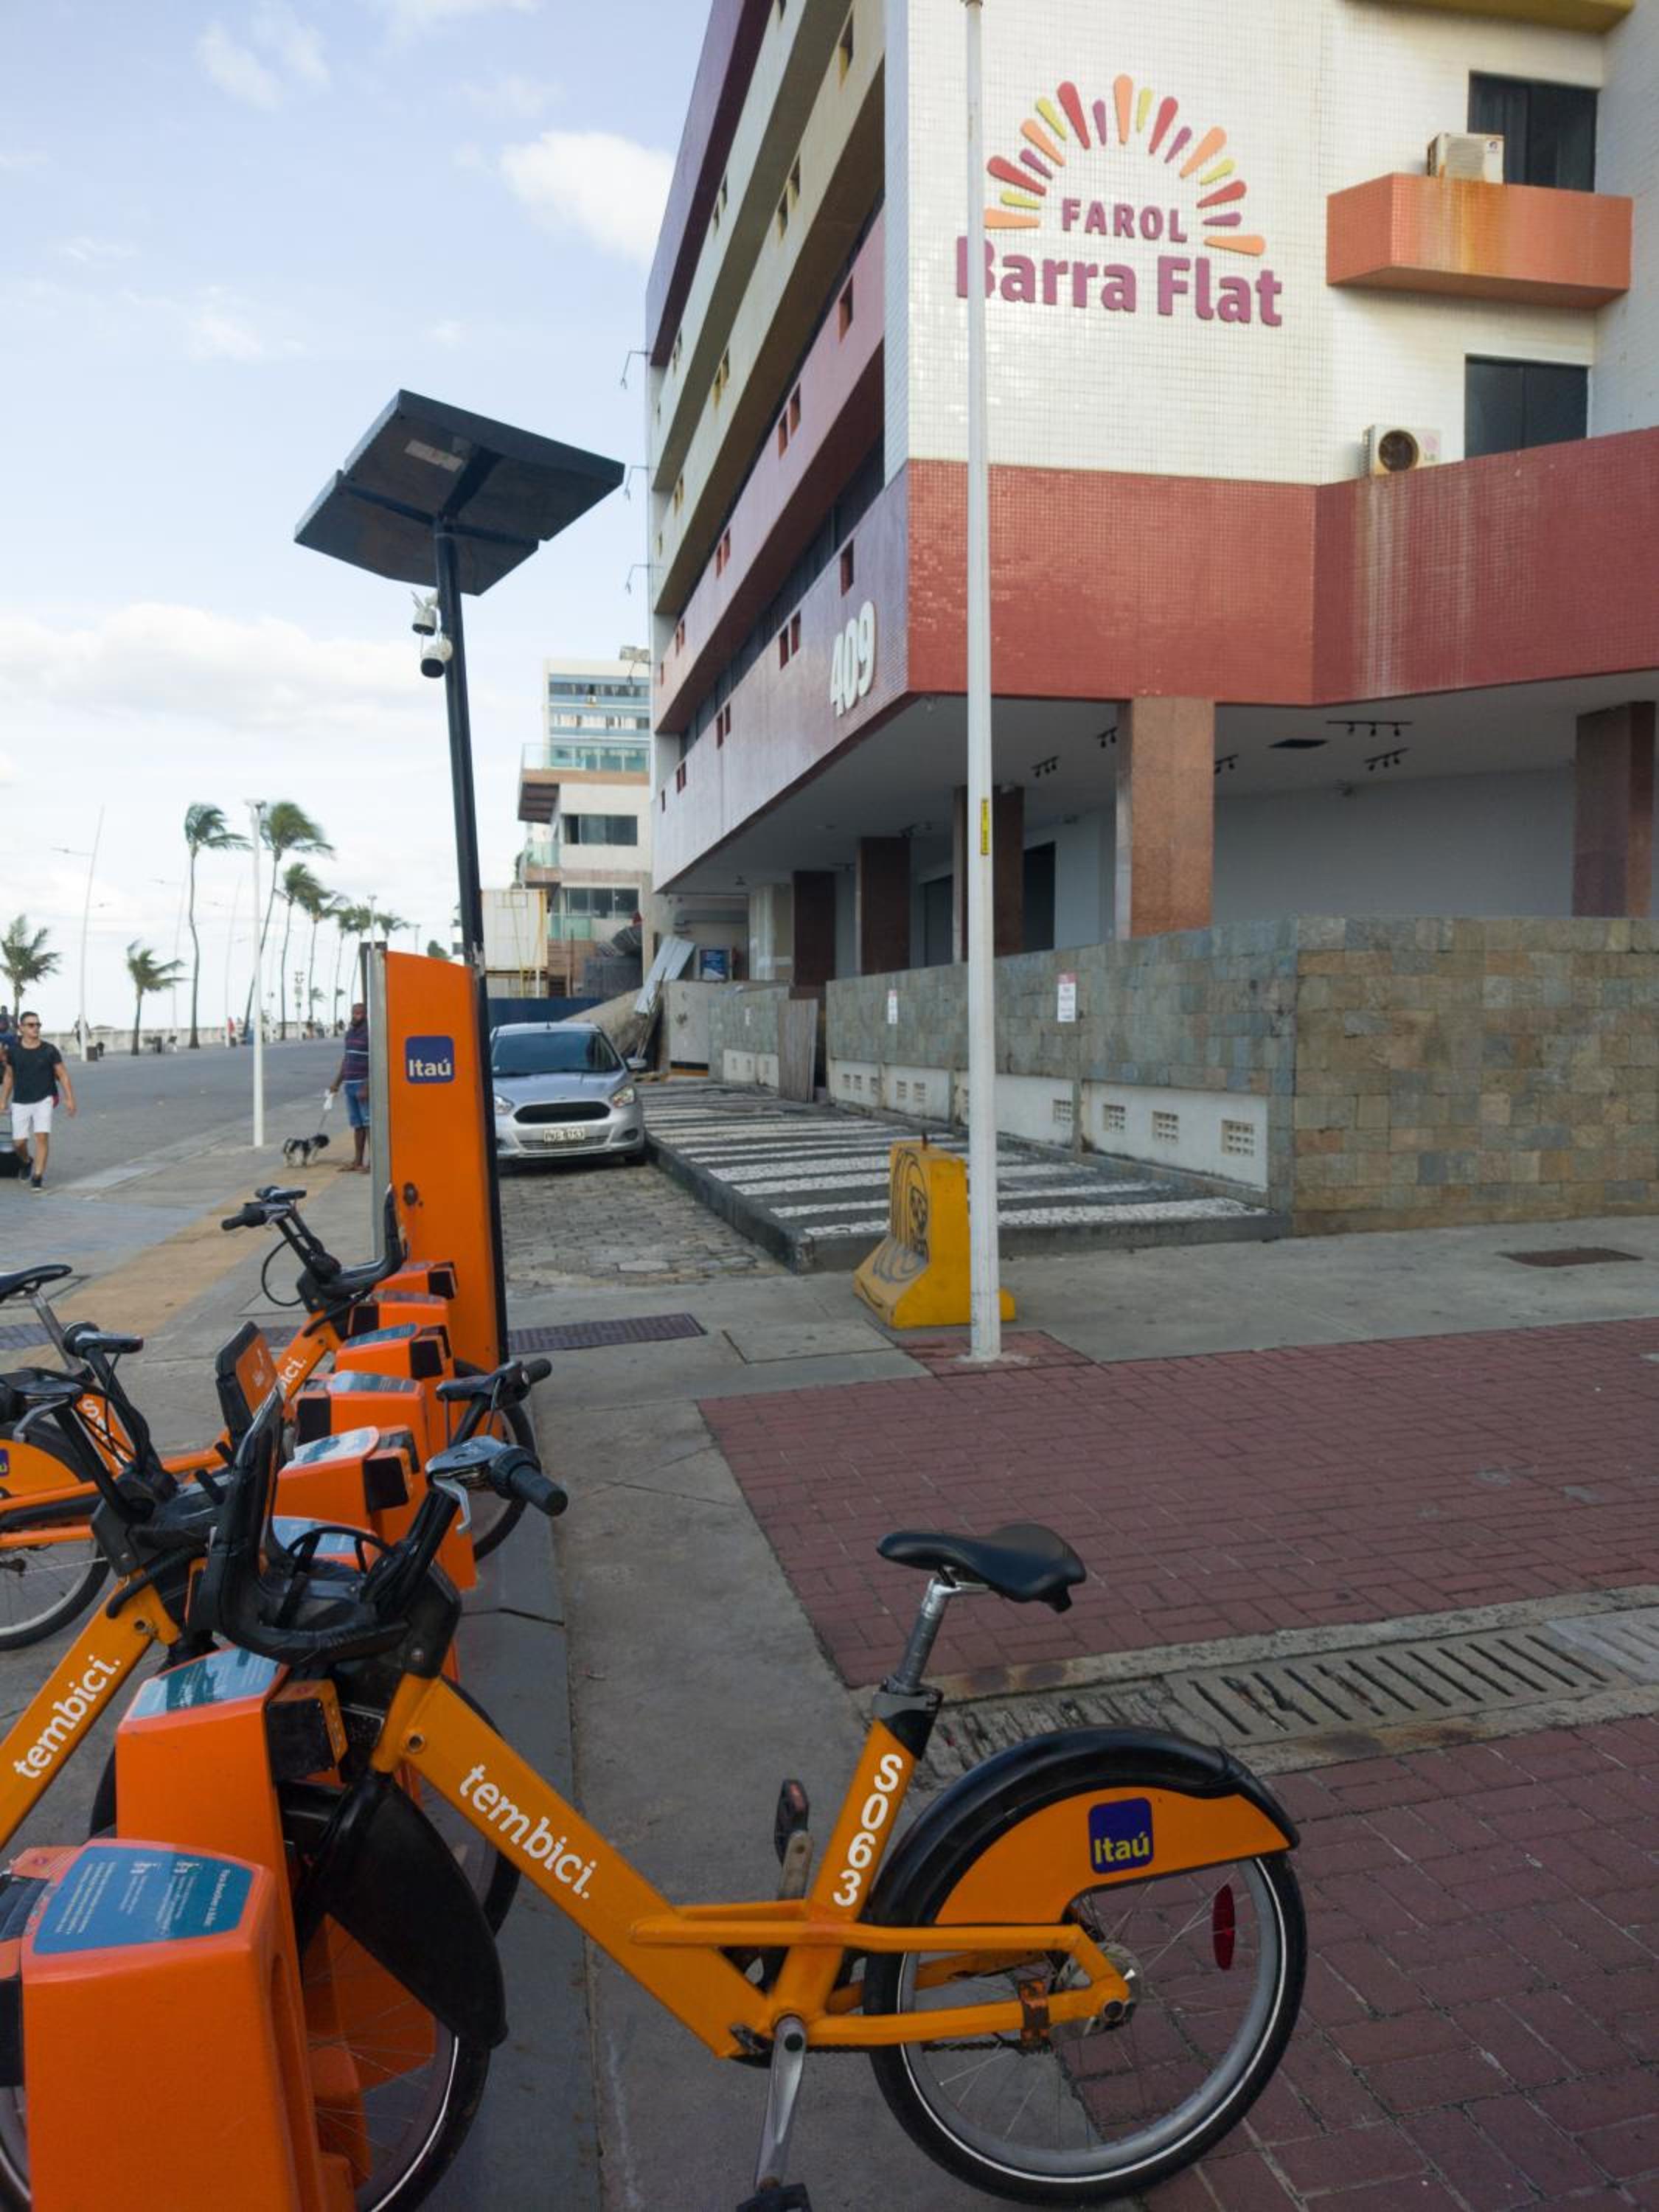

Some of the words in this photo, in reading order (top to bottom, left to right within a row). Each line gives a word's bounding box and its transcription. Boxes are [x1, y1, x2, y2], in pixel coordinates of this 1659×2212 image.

[1062, 198, 1188, 243] FAROL
[956, 234, 1137, 313] Barra
[1157, 255, 1283, 327] Flat
[830, 600, 875, 717] 409
[408, 1057, 452, 1077] Itaú
[13, 1655, 121, 1778] tembici.
[459, 1764, 597, 1899] tembici.
[832, 1753, 903, 1907] S063
[1093, 1831, 1150, 1864] Itaú
